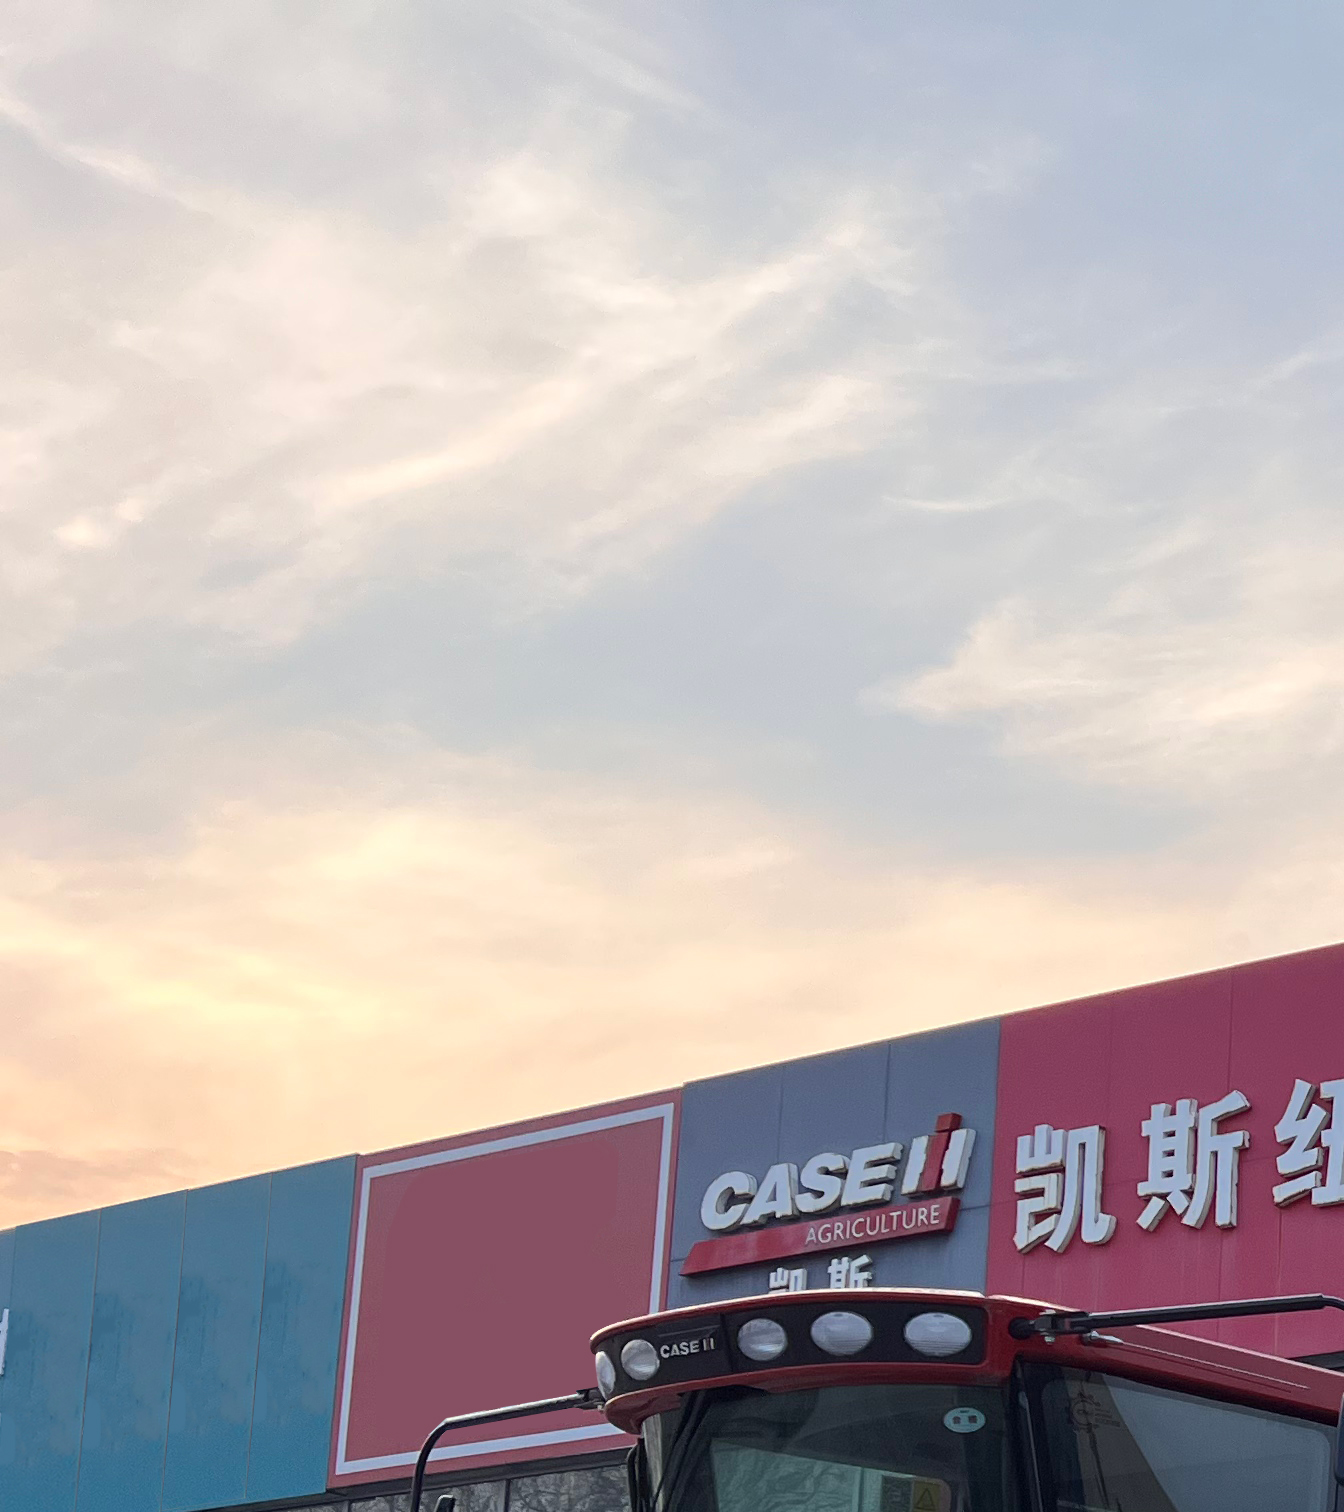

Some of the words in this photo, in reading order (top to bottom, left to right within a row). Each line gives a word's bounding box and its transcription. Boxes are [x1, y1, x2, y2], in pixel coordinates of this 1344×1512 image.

[700, 1141, 904, 1233] CASE
[804, 1204, 941, 1246] AGRICULTURE
[659, 1340, 700, 1359] CASE
